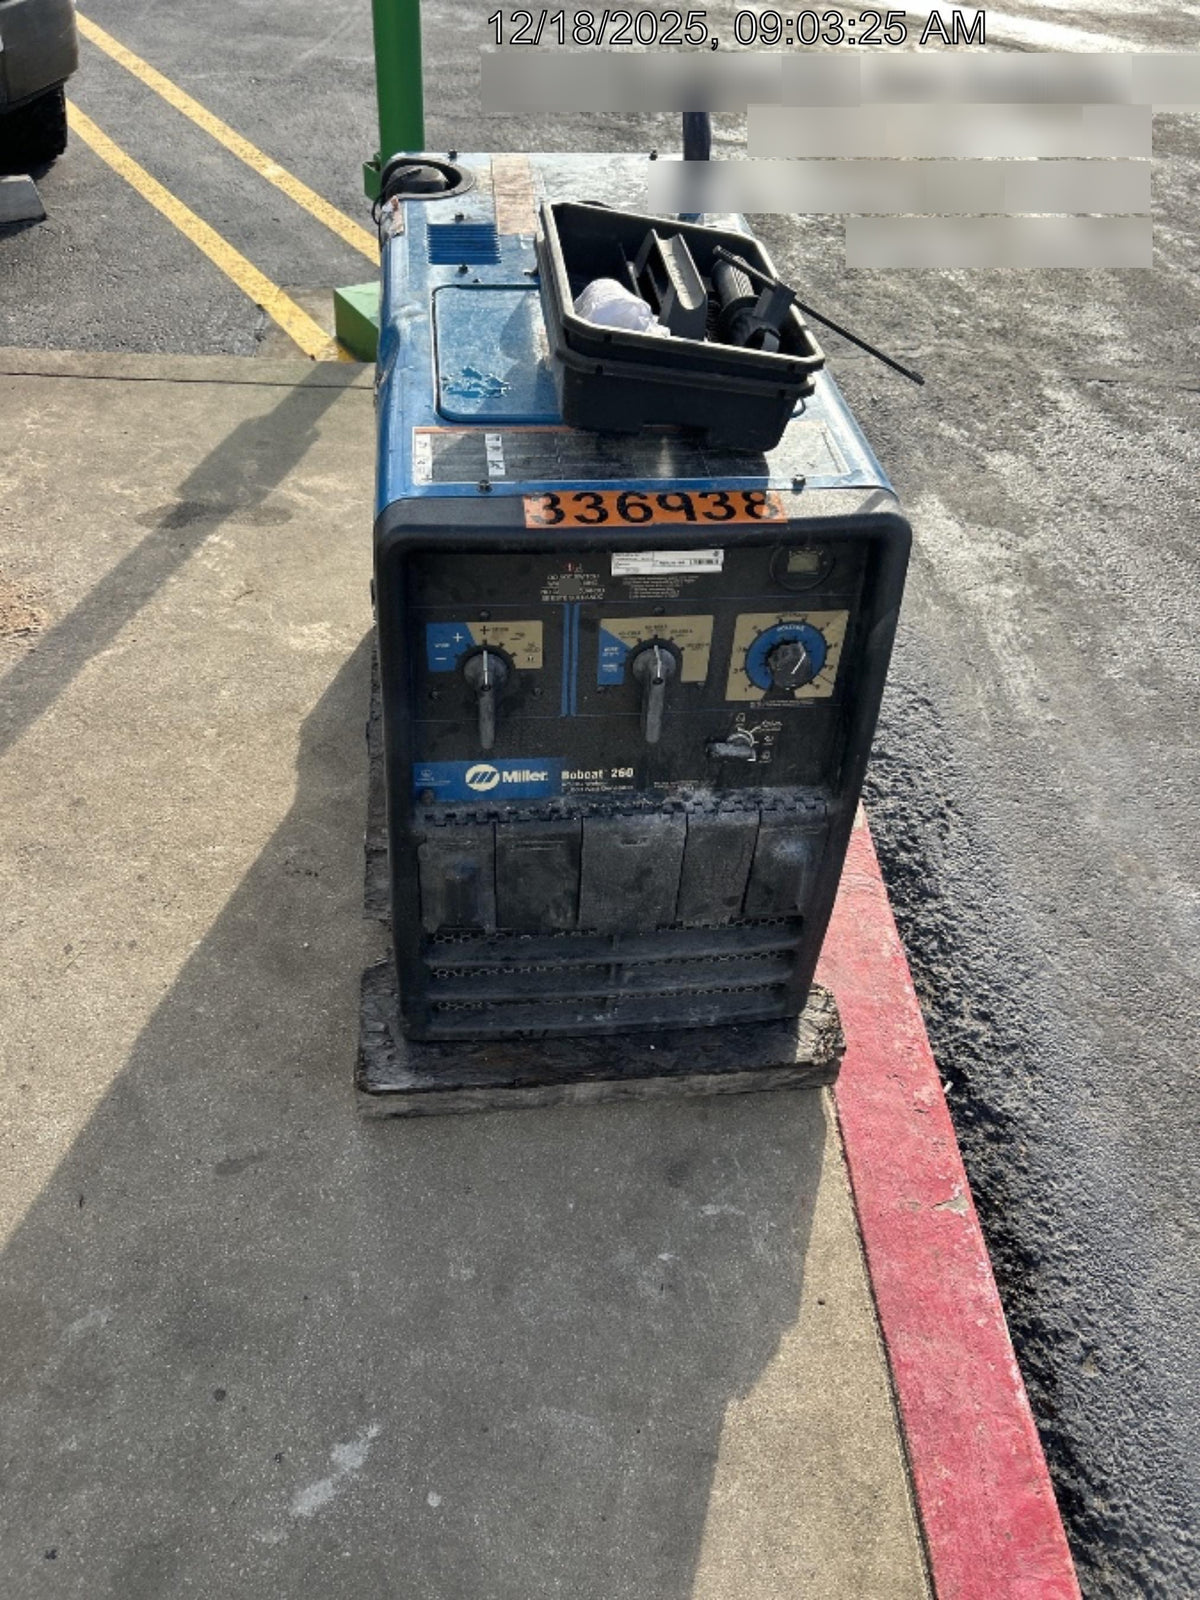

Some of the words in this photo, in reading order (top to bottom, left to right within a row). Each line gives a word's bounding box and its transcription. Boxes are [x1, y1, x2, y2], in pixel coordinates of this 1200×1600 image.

[529, 490, 779, 525] 336938
[502, 769, 547, 783] Miller
[561, 769, 603, 780] Bobcat
[610, 767, 634, 778] 260
